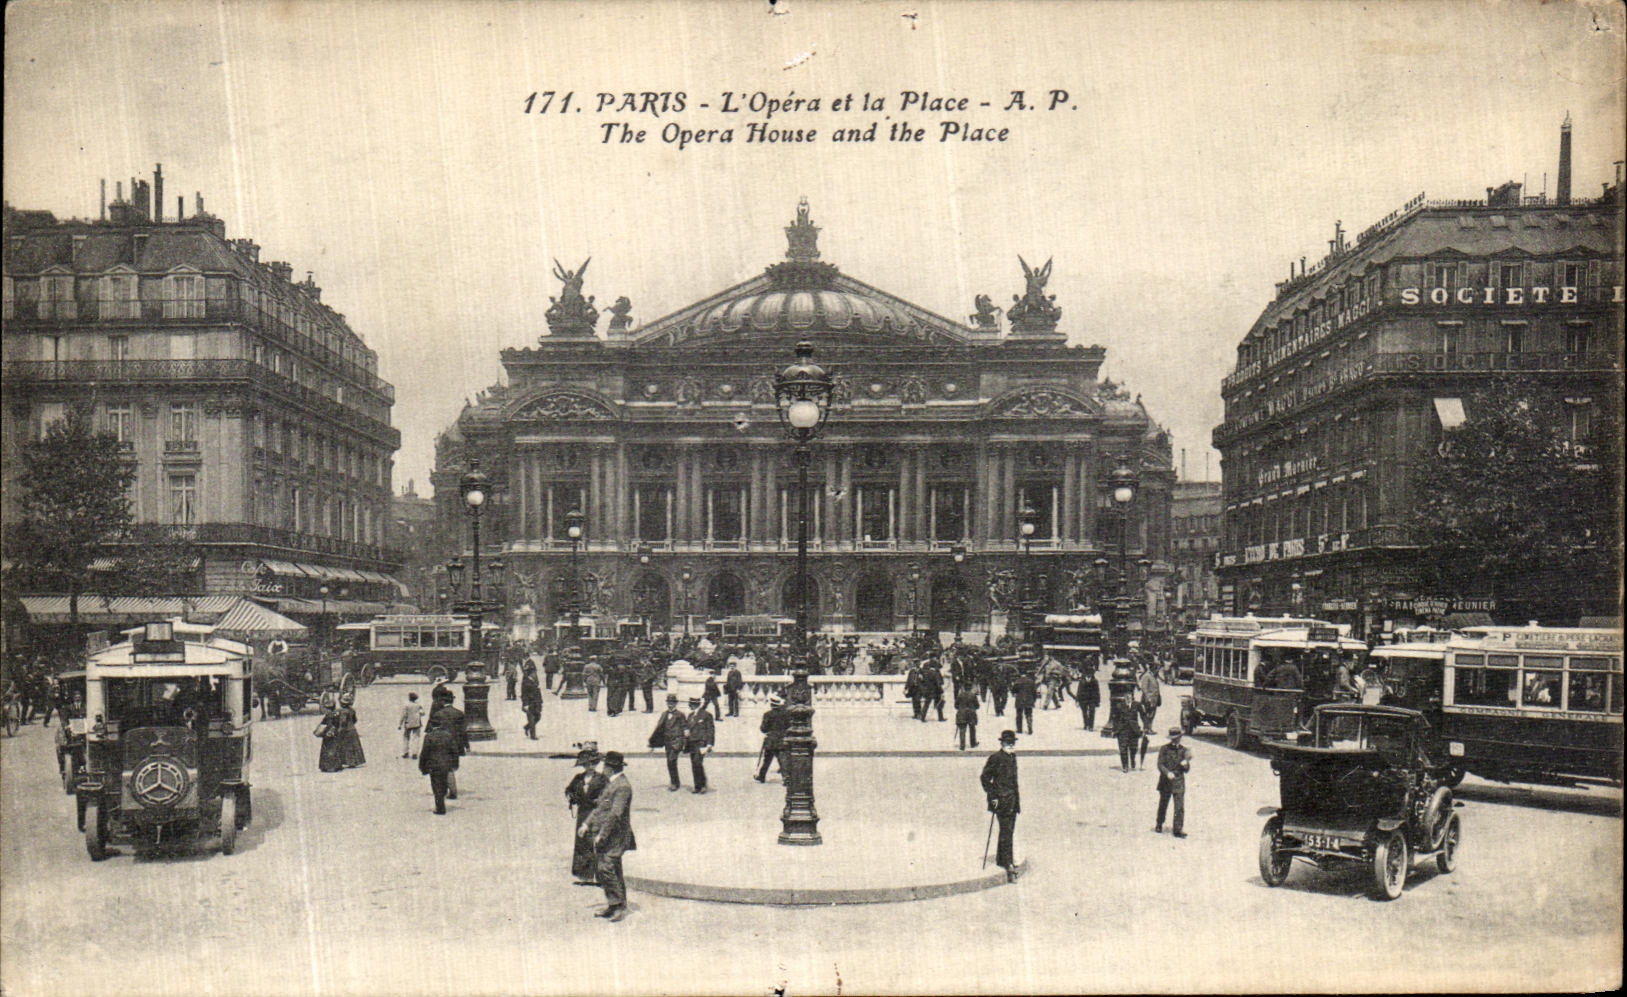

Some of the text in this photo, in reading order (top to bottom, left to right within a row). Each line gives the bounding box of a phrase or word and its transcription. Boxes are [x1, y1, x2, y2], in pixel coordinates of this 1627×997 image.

[1401, 286, 1578, 305] SOCIETE
[1338, 297, 1371, 329] MAGGI
[1503, 631, 1511, 641] P
[1460, 707, 1528, 717] COMPAGNIE
